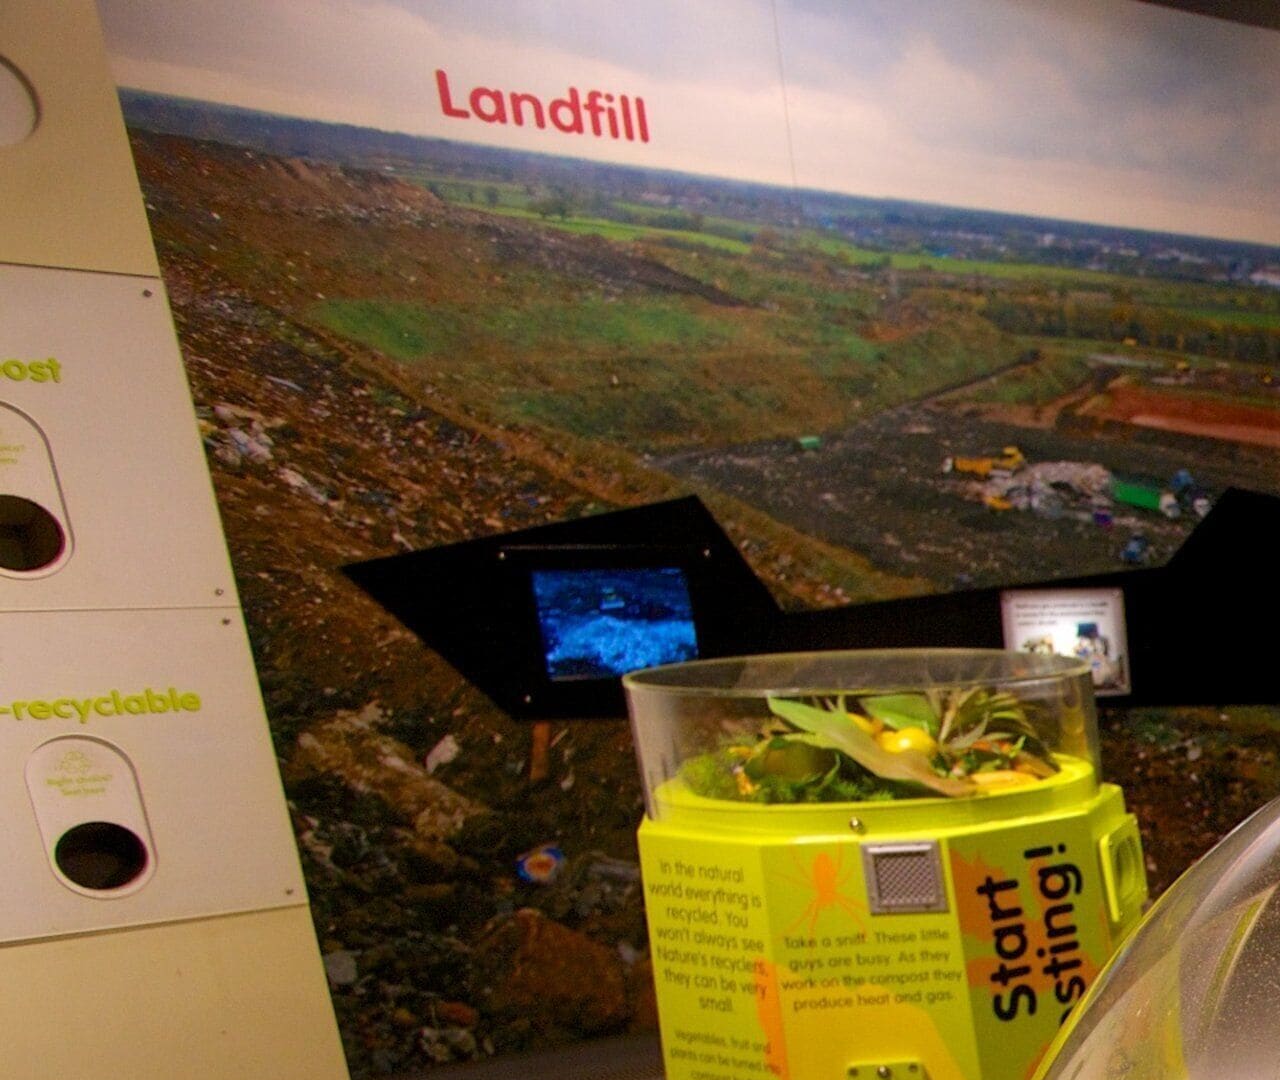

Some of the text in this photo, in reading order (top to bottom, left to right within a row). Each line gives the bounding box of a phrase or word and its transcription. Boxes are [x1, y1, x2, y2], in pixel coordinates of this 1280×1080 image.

[435, 69, 649, 143] Landfill
[0, 357, 61, 384] ost
[675, 860, 695, 878] the
[698, 865, 744, 883] natural
[648, 881, 762, 911] world everything is
[725, 910, 748, 929] You
[693, 931, 737, 950] always
[741, 938, 764, 953] see
[784, 935, 817, 949] Take
[822, 936, 832, 948] a
[874, 931, 917, 944] These
[919, 928, 949, 941] little
[1024, 843, 1086, 1026] sting!
[976, 875, 1037, 1022] Start
[788, 957, 824, 973] guys
[828, 956, 852, 968] are
[898, 950, 915, 963] As
[919, 950, 950, 963] they
[664, 967, 767, 1000] they can be very
[782, 968, 962, 991] work on the compost they
[793, 997, 853, 1013] produce
[857, 993, 889, 1006] heat
[895, 990, 922, 1004] and
